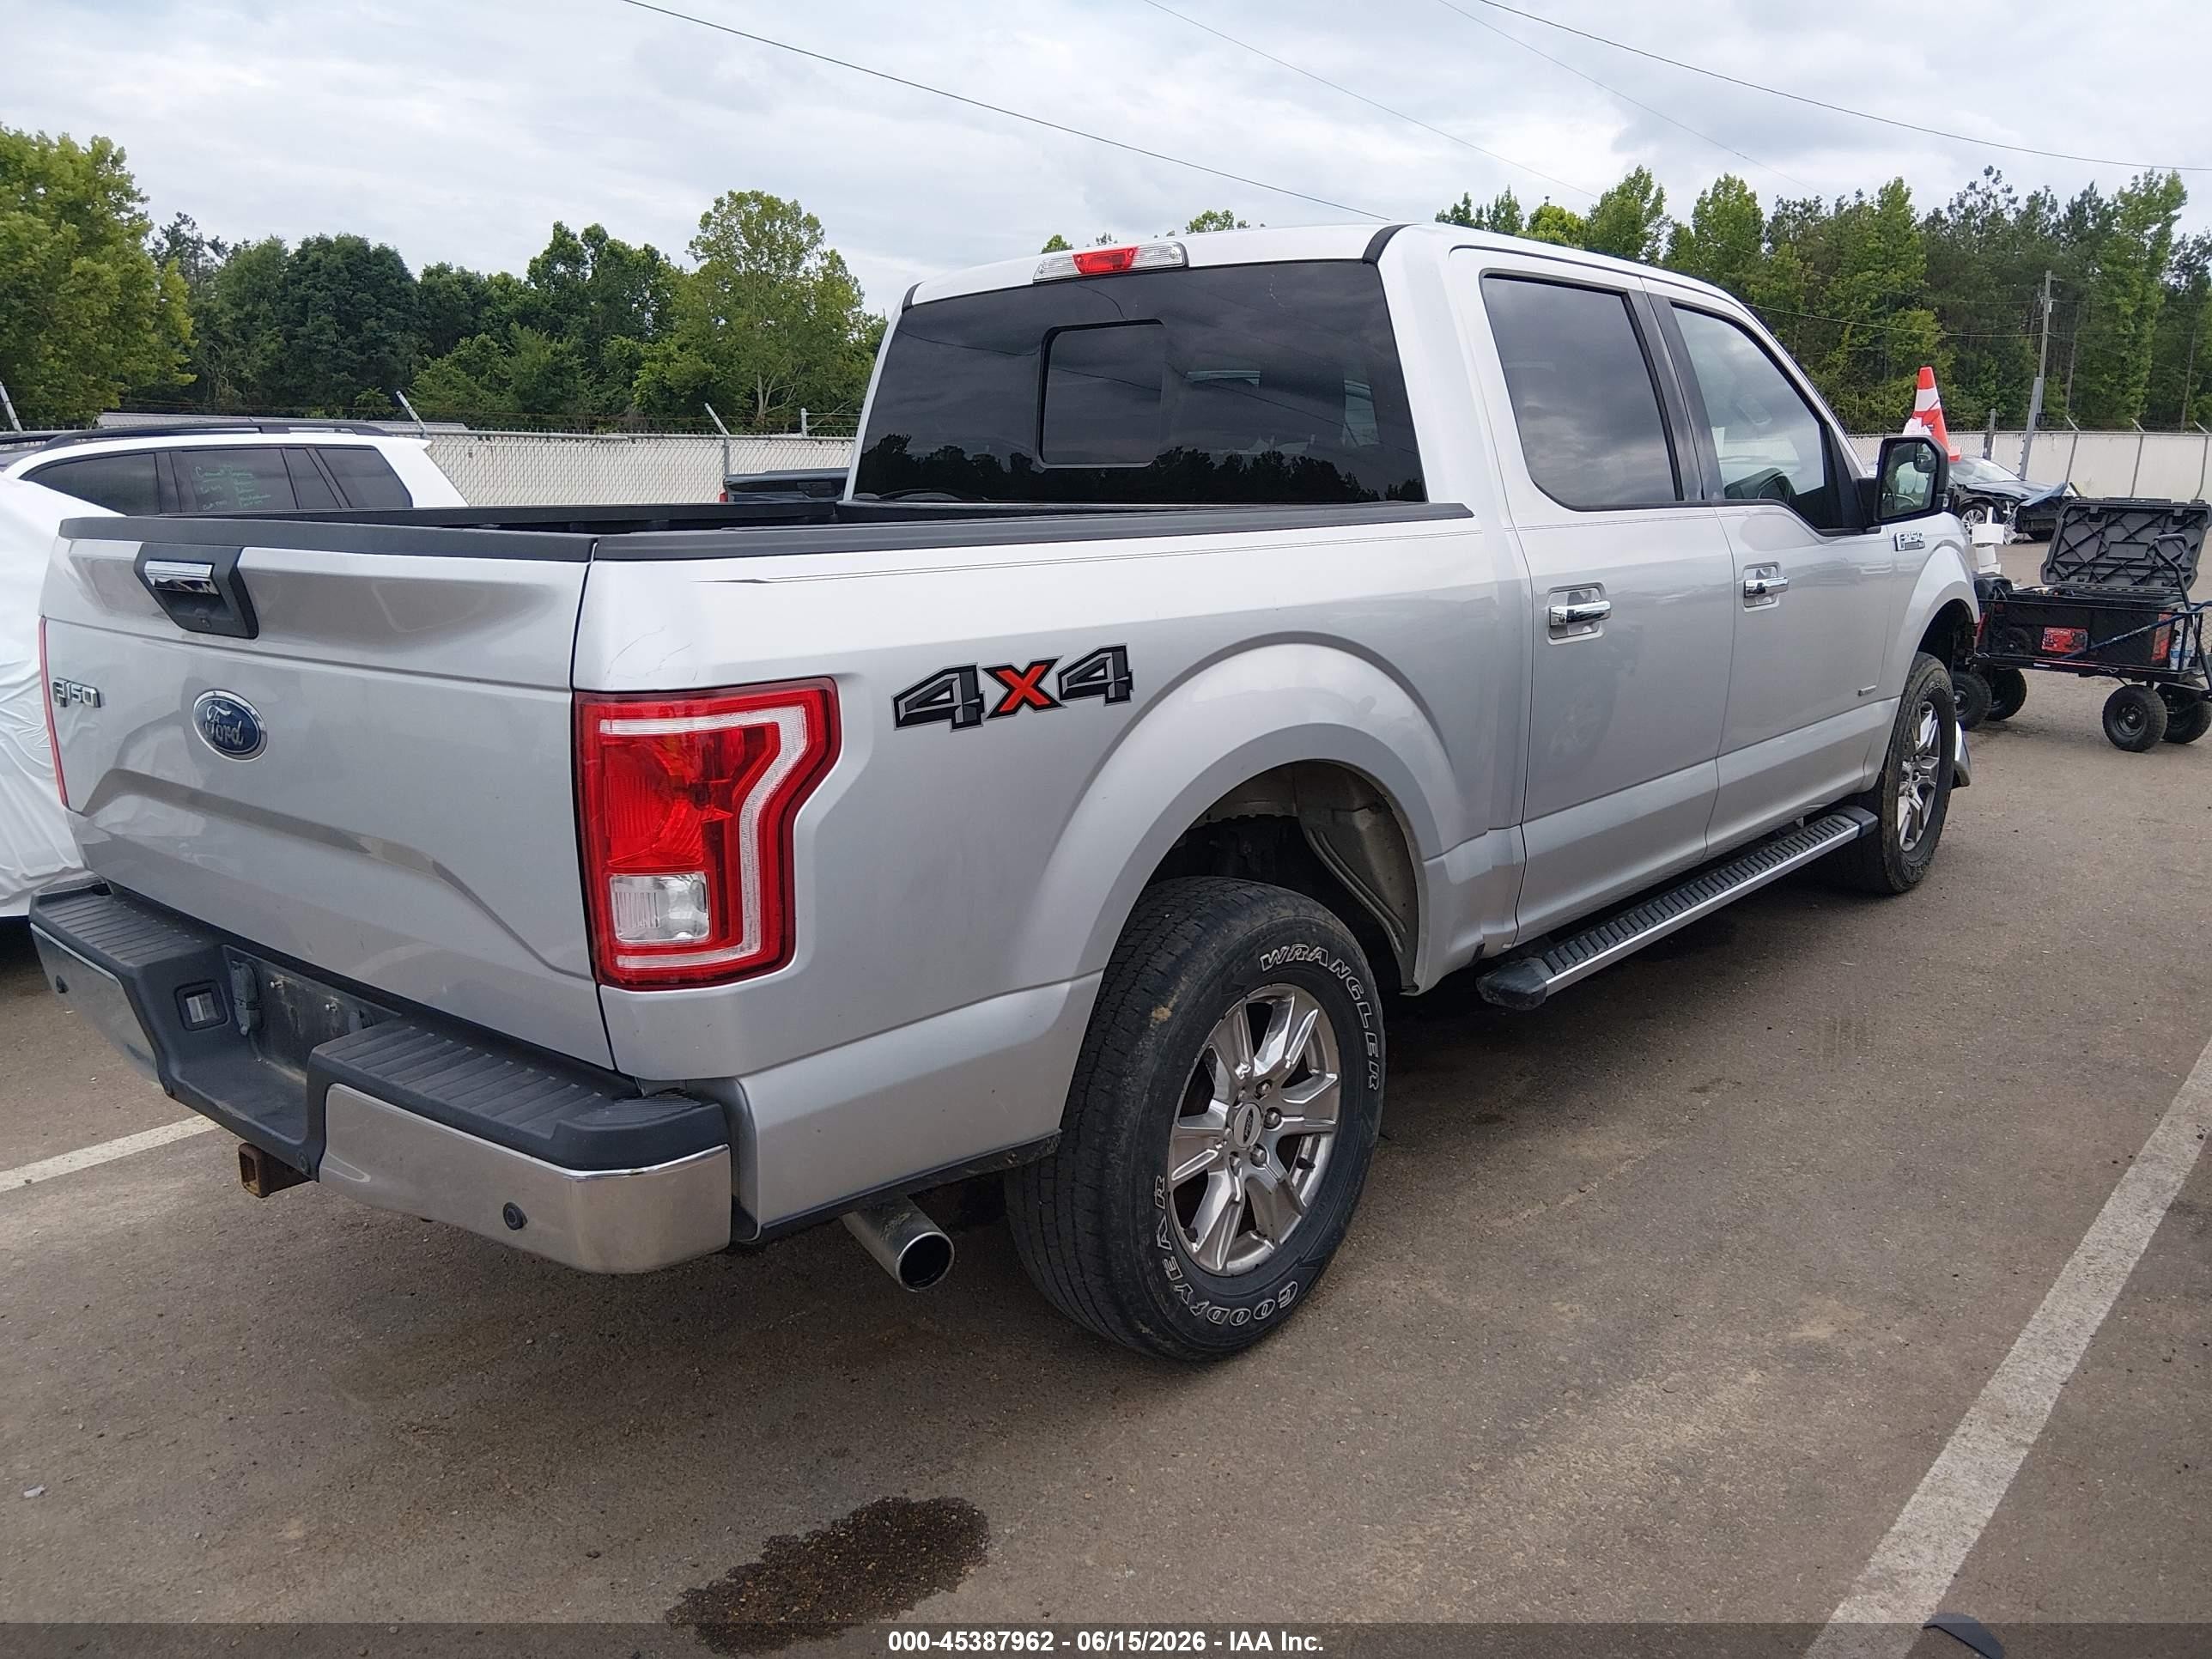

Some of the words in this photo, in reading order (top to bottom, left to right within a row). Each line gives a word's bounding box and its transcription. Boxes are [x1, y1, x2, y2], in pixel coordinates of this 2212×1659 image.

[205, 704, 244, 745] Ford
[1260, 944, 1380, 1091] WRANGLER
[1154, 1175, 1297, 1326] GOODYEAR
